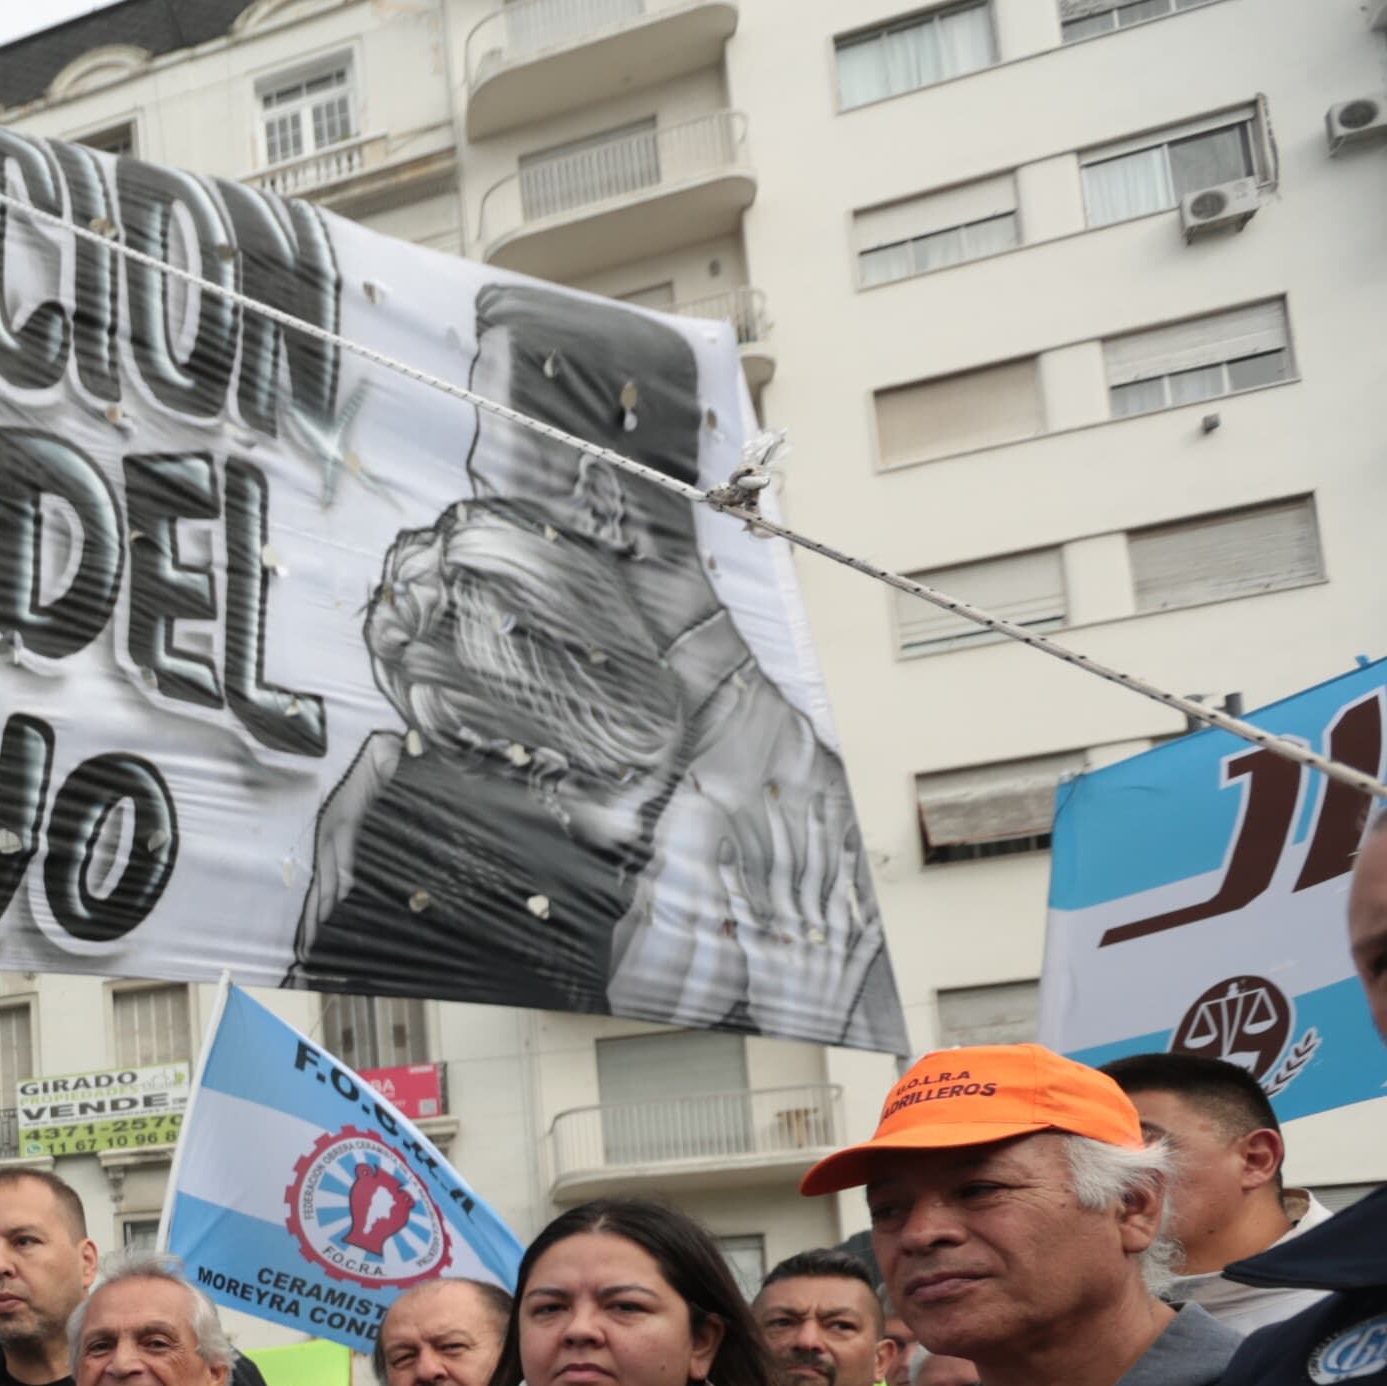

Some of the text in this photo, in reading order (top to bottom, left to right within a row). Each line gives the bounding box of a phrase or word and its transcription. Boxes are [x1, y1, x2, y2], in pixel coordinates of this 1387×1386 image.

[19, 1071, 138, 1097] GIRADO
[20, 1085, 140, 1106] PROPIEDADES
[22, 1092, 169, 1121] VENDE
[303, 1161, 326, 1221] FEDERACION
[323, 1141, 354, 1164] OBRERA
[197, 1265, 300, 1318] MOREYRA
